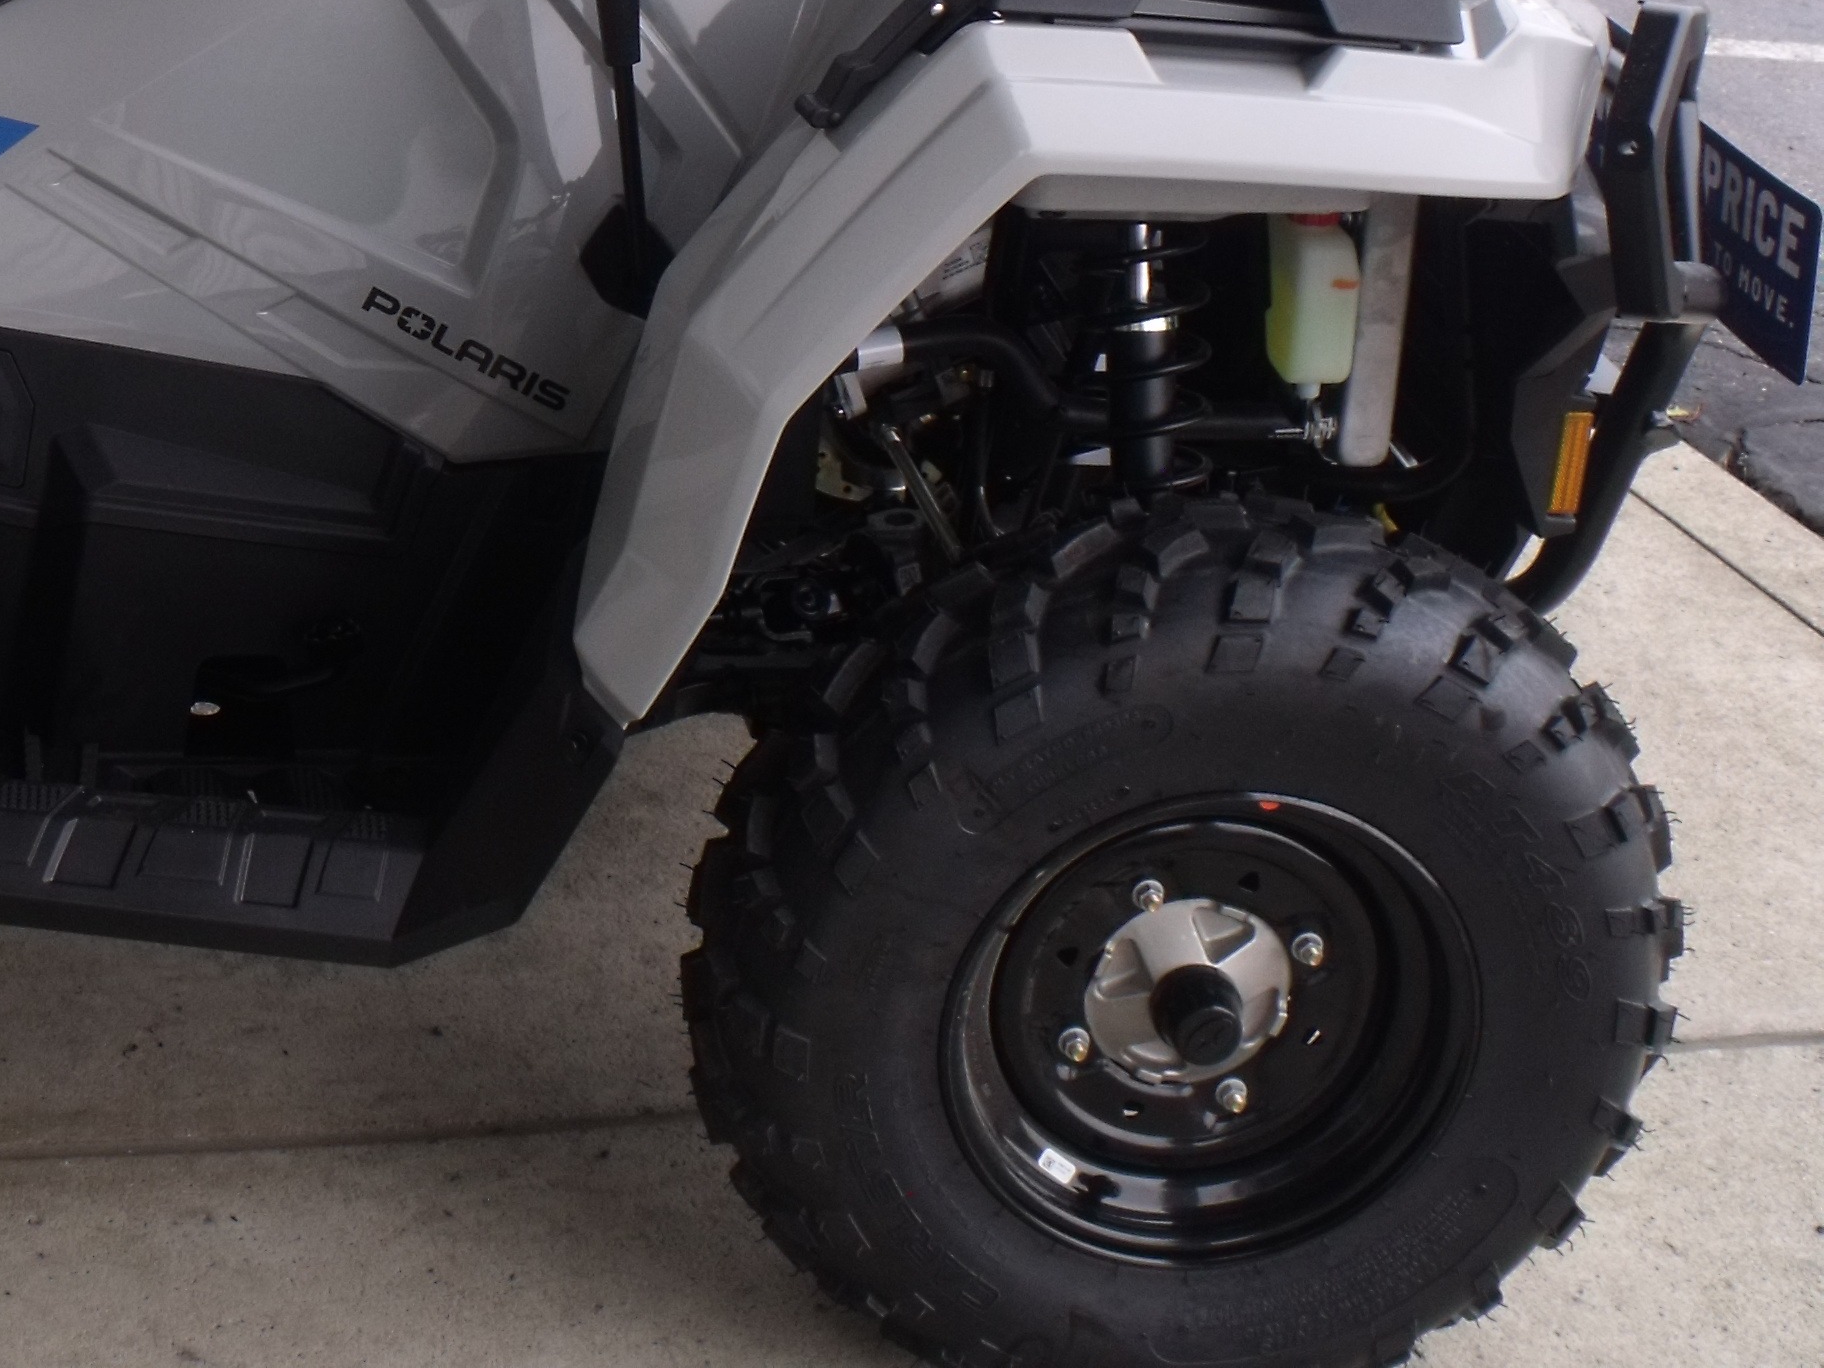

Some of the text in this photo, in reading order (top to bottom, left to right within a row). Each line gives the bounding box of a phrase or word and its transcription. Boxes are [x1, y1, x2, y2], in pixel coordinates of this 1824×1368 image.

[1703, 142, 1806, 279] PRICE
[1713, 240, 1733, 277] TO
[361, 286, 571, 412] POLARIS
